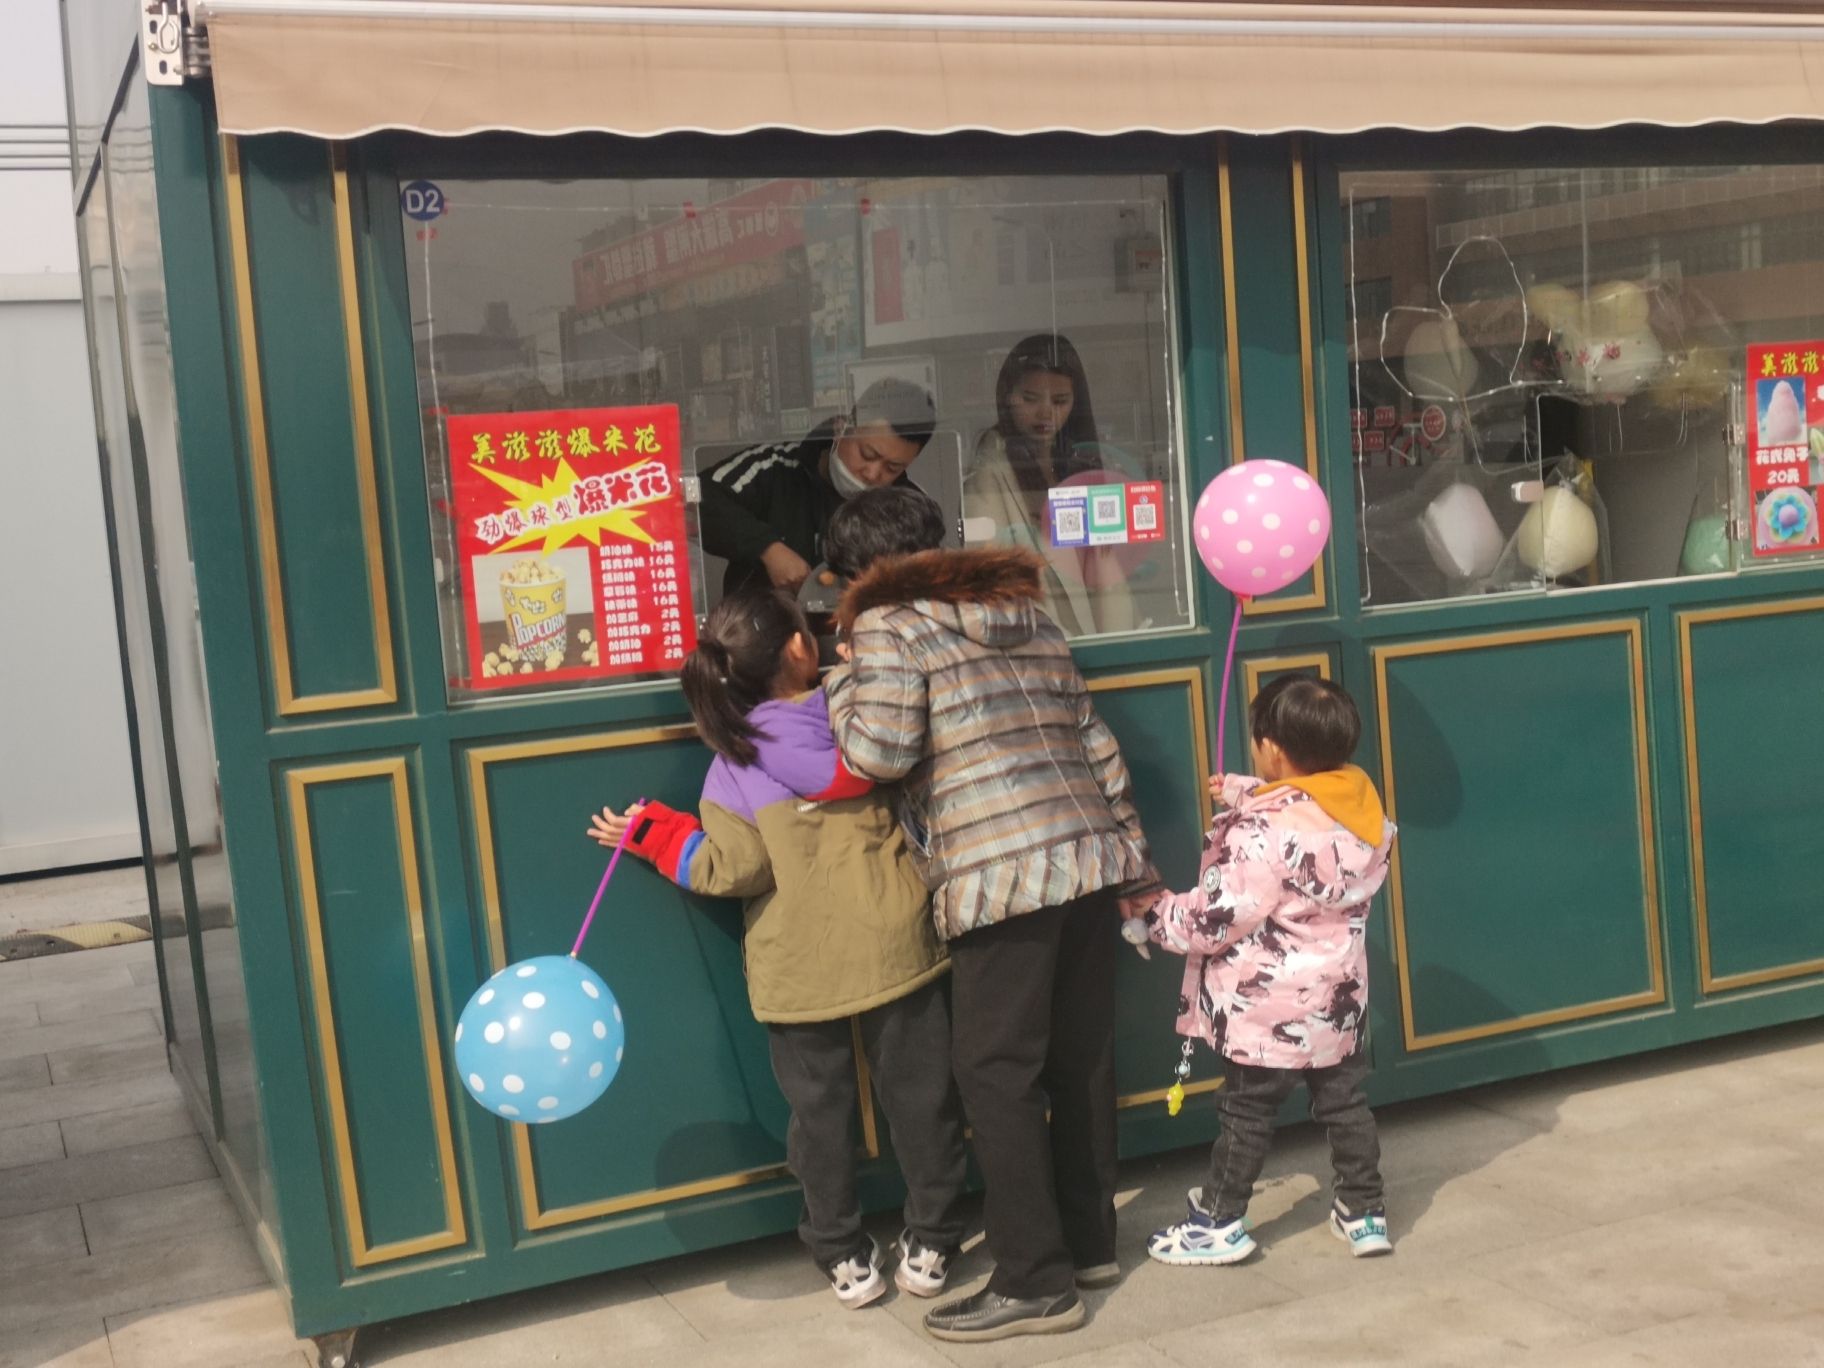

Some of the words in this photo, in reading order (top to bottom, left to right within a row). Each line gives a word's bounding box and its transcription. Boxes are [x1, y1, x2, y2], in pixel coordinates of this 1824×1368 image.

[405, 188, 441, 213] D2
[1761, 351, 1824, 376] 美滋滋
[573, 463, 671, 517] 爆米花
[511, 612, 567, 648] POPCORN
